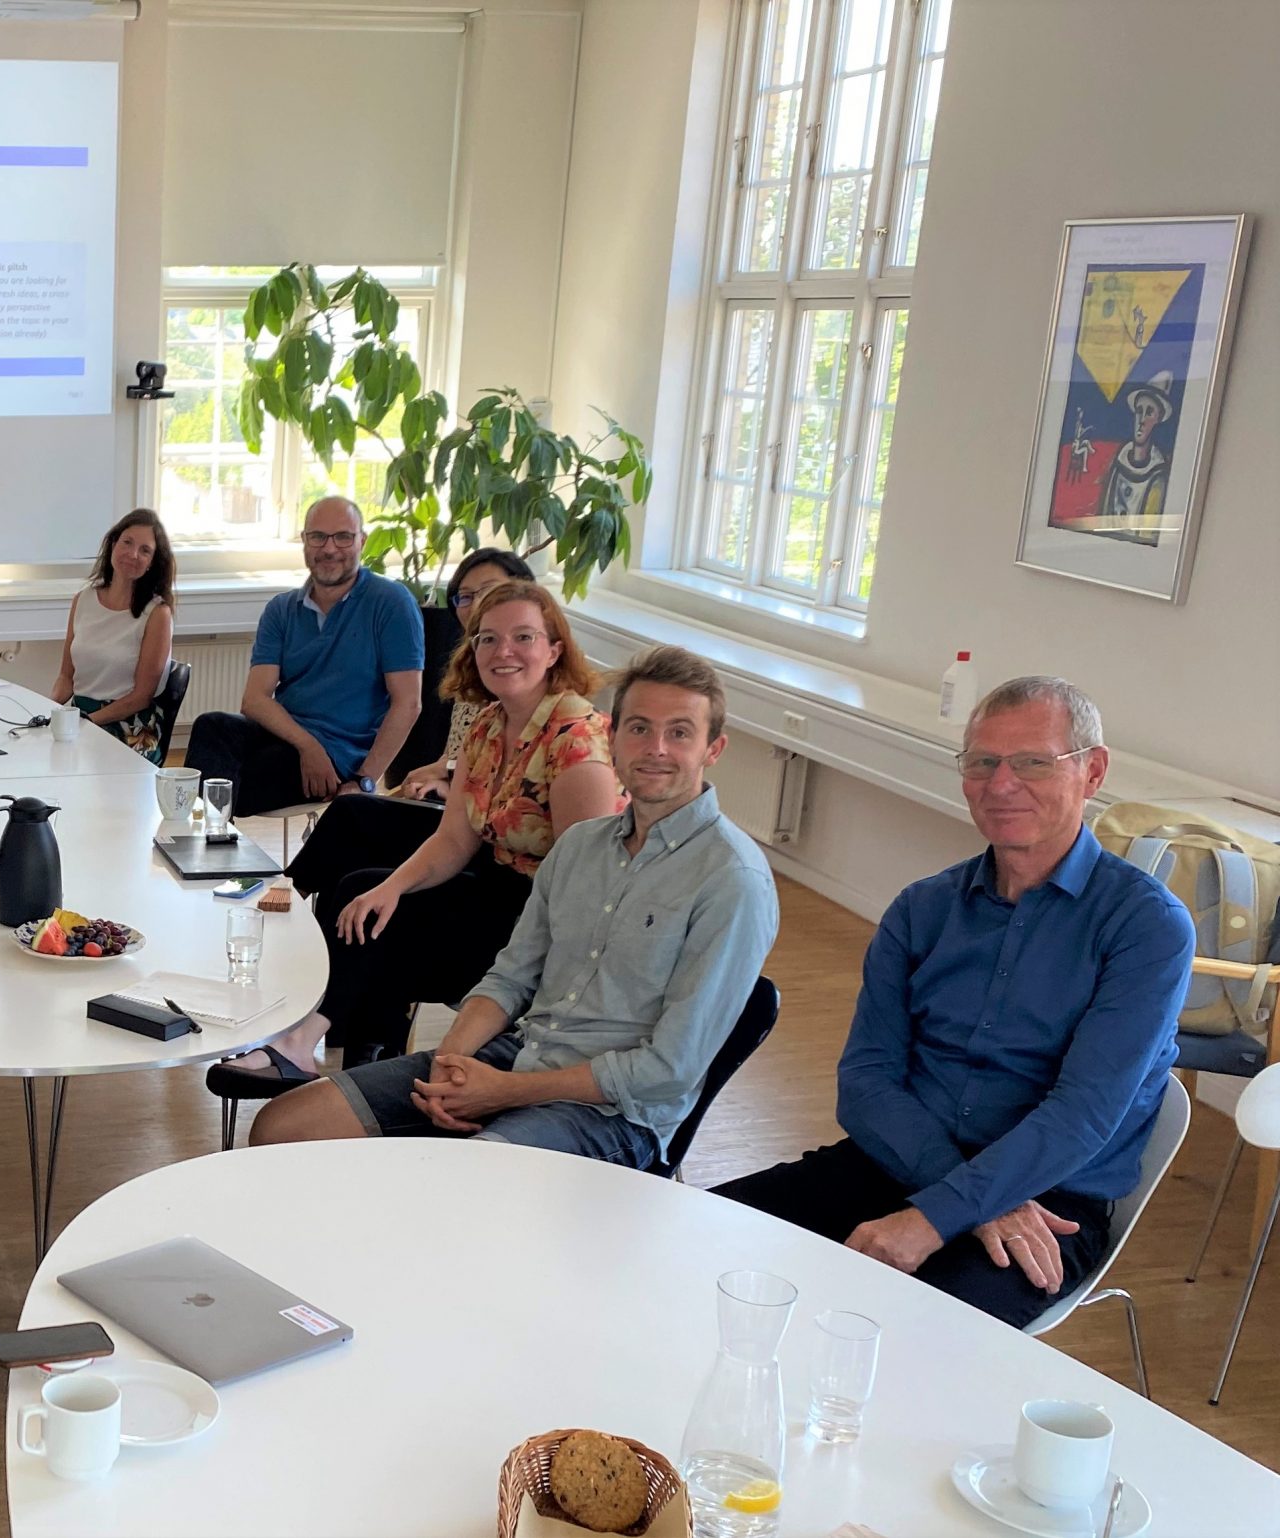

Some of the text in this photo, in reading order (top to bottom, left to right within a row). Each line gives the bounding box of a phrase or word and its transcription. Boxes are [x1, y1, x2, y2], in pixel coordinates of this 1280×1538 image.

[7, 263, 27, 272] pitch
[26, 276, 54, 286] looking
[55, 276, 67, 286] for
[6, 304, 51, 312] perspective
[7, 317, 19, 325] the
[15, 329, 47, 339] already)
